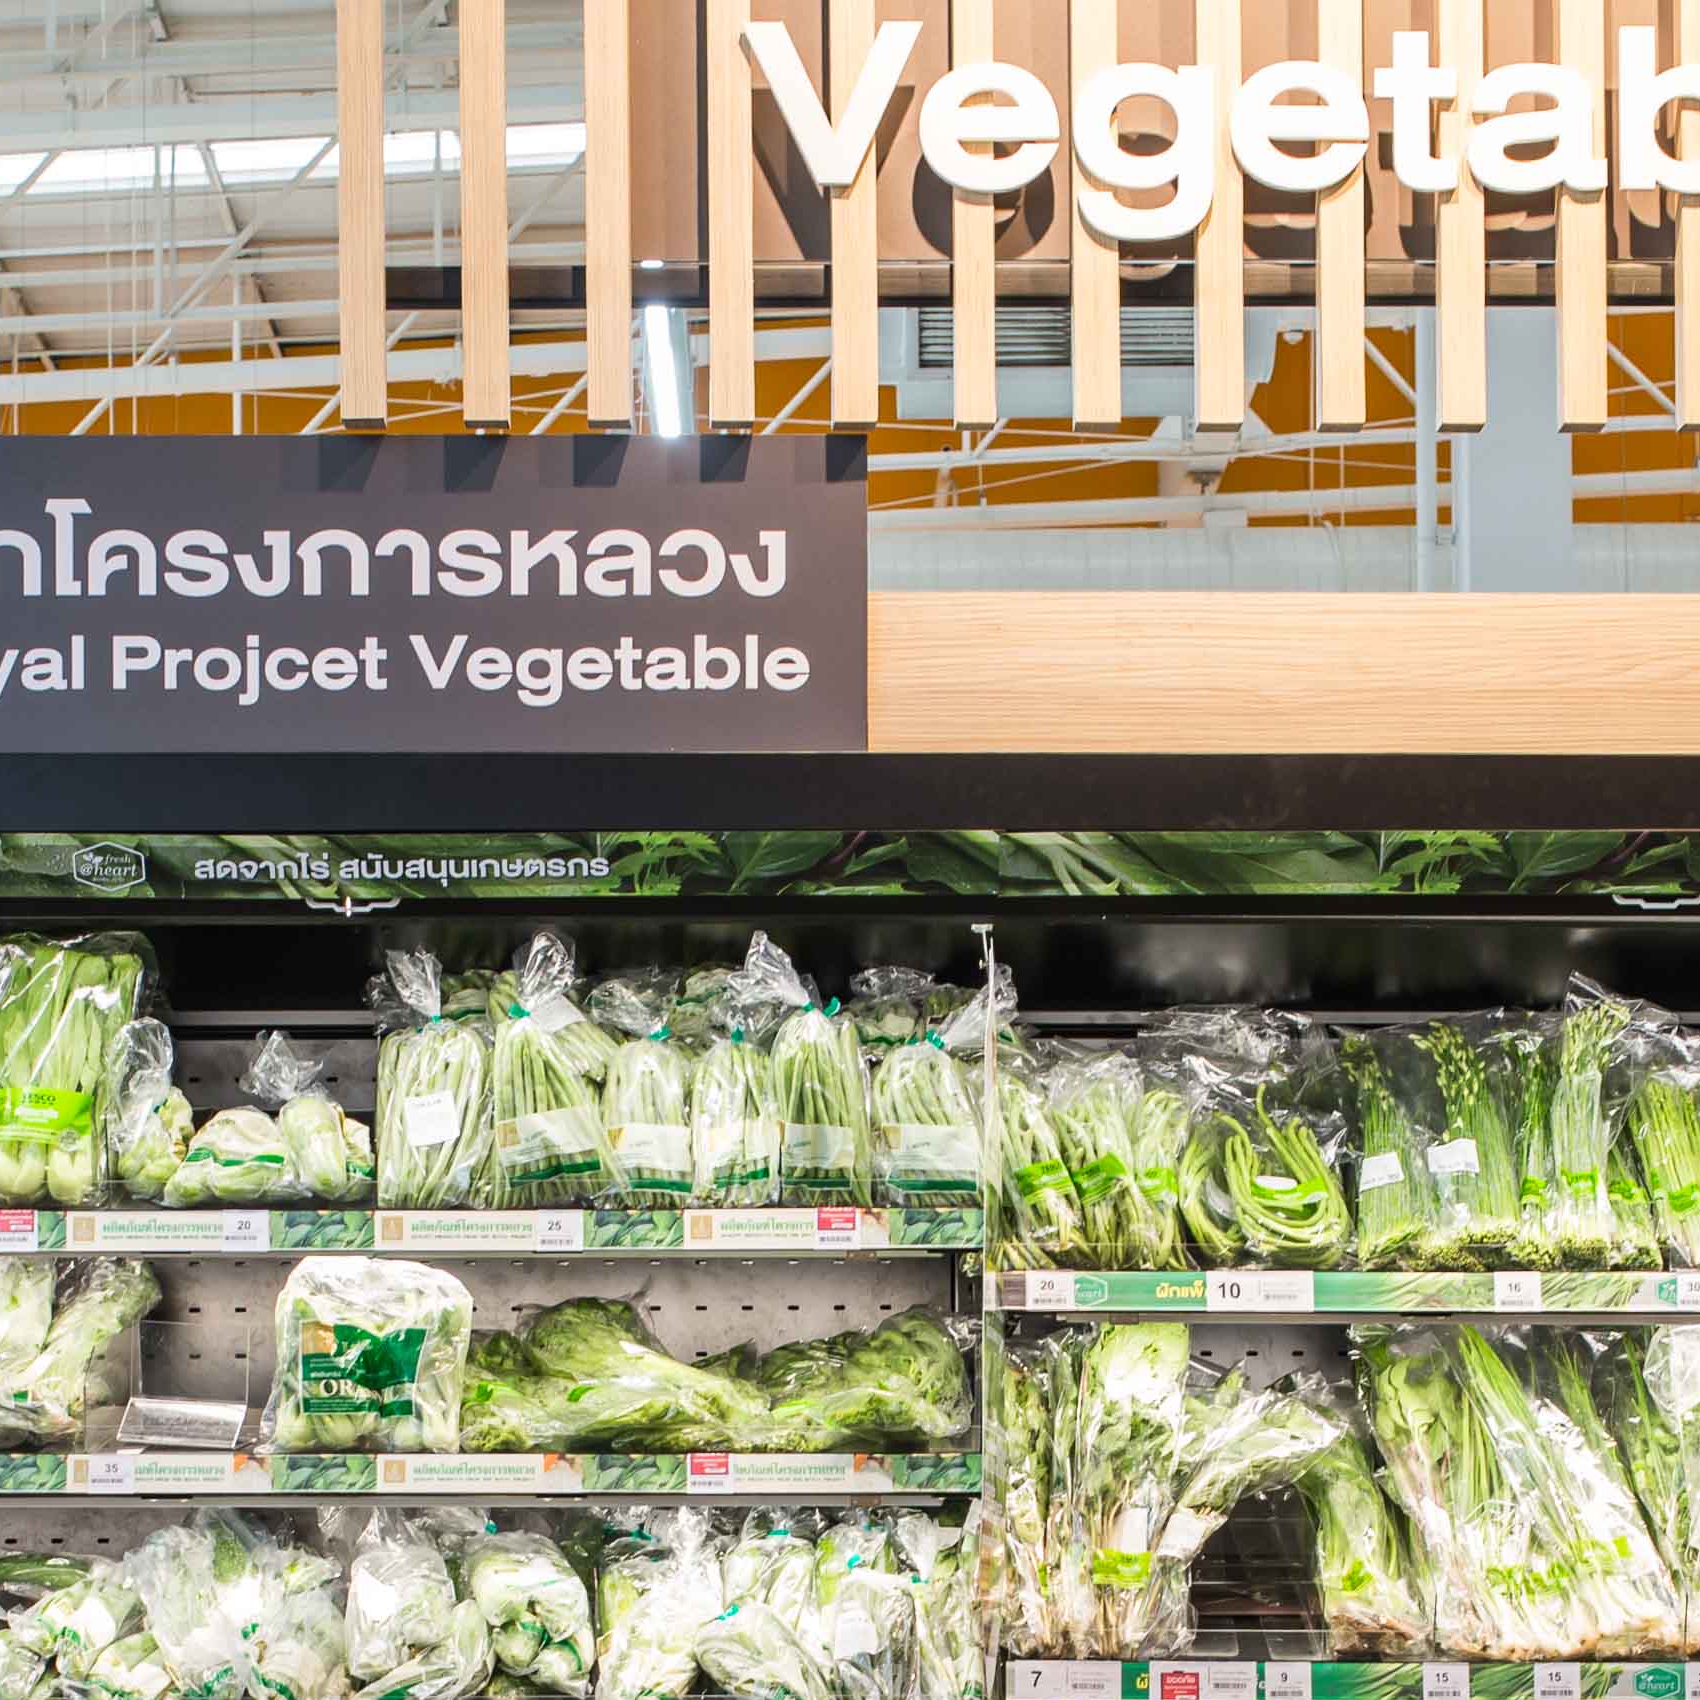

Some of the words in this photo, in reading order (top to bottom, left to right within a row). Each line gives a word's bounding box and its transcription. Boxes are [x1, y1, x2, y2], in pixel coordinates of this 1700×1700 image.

[112, 635, 388, 708] Projcet
[410, 635, 811, 708] Vegetable
[80, 863, 138, 877] @heart
[238, 1221, 250, 1230] 20
[548, 1221, 561, 1230] 25
[1041, 1281, 1054, 1290] 20
[1219, 1283, 1240, 1298] 10
[106, 1464, 118, 1473] 35
[1031, 1671, 1042, 1687] 7
[1281, 1673, 1287, 1682] 9
[1436, 1673, 1448, 1682] 15
[1549, 1672, 1561, 1682] 15
